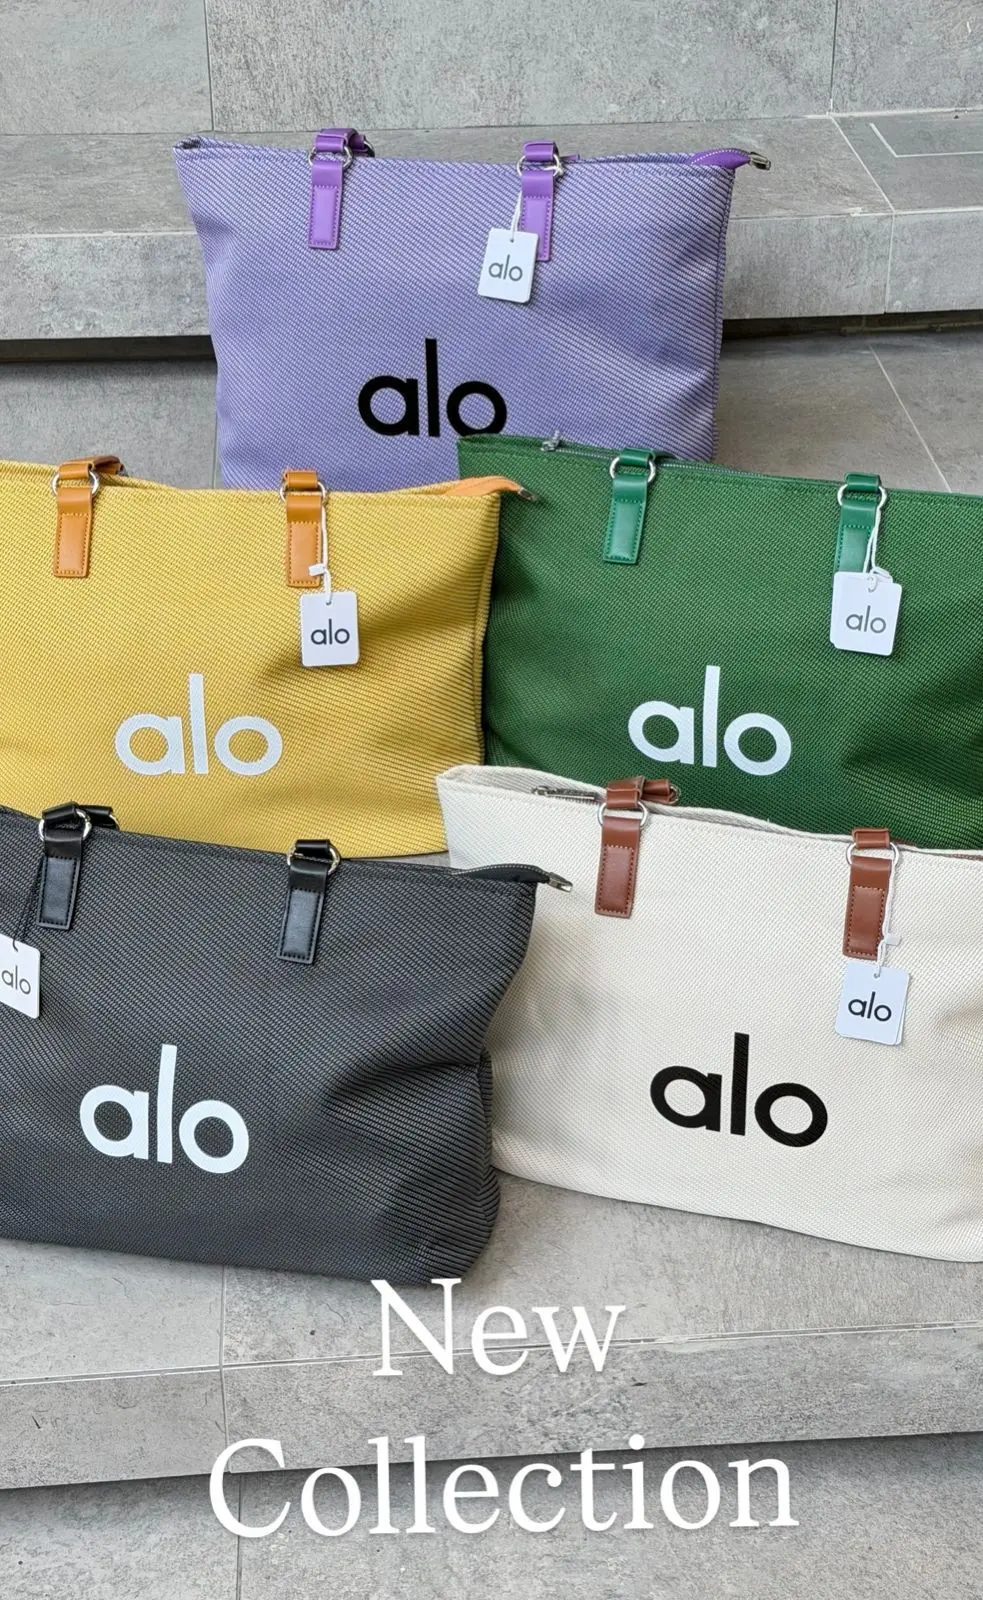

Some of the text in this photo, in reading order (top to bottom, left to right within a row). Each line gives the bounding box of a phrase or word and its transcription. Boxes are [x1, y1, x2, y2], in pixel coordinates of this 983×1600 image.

[488, 254, 523, 282] alo
[358, 338, 507, 437] alo
[310, 618, 350, 645] alo
[846, 605, 887, 634] alo
[115, 673, 283, 776] alo
[627, 665, 792, 776] alo
[1, 964, 31, 994] alo
[847, 991, 892, 1022] alo
[79, 1043, 250, 1174] alo
[650, 1032, 828, 1148] alo
